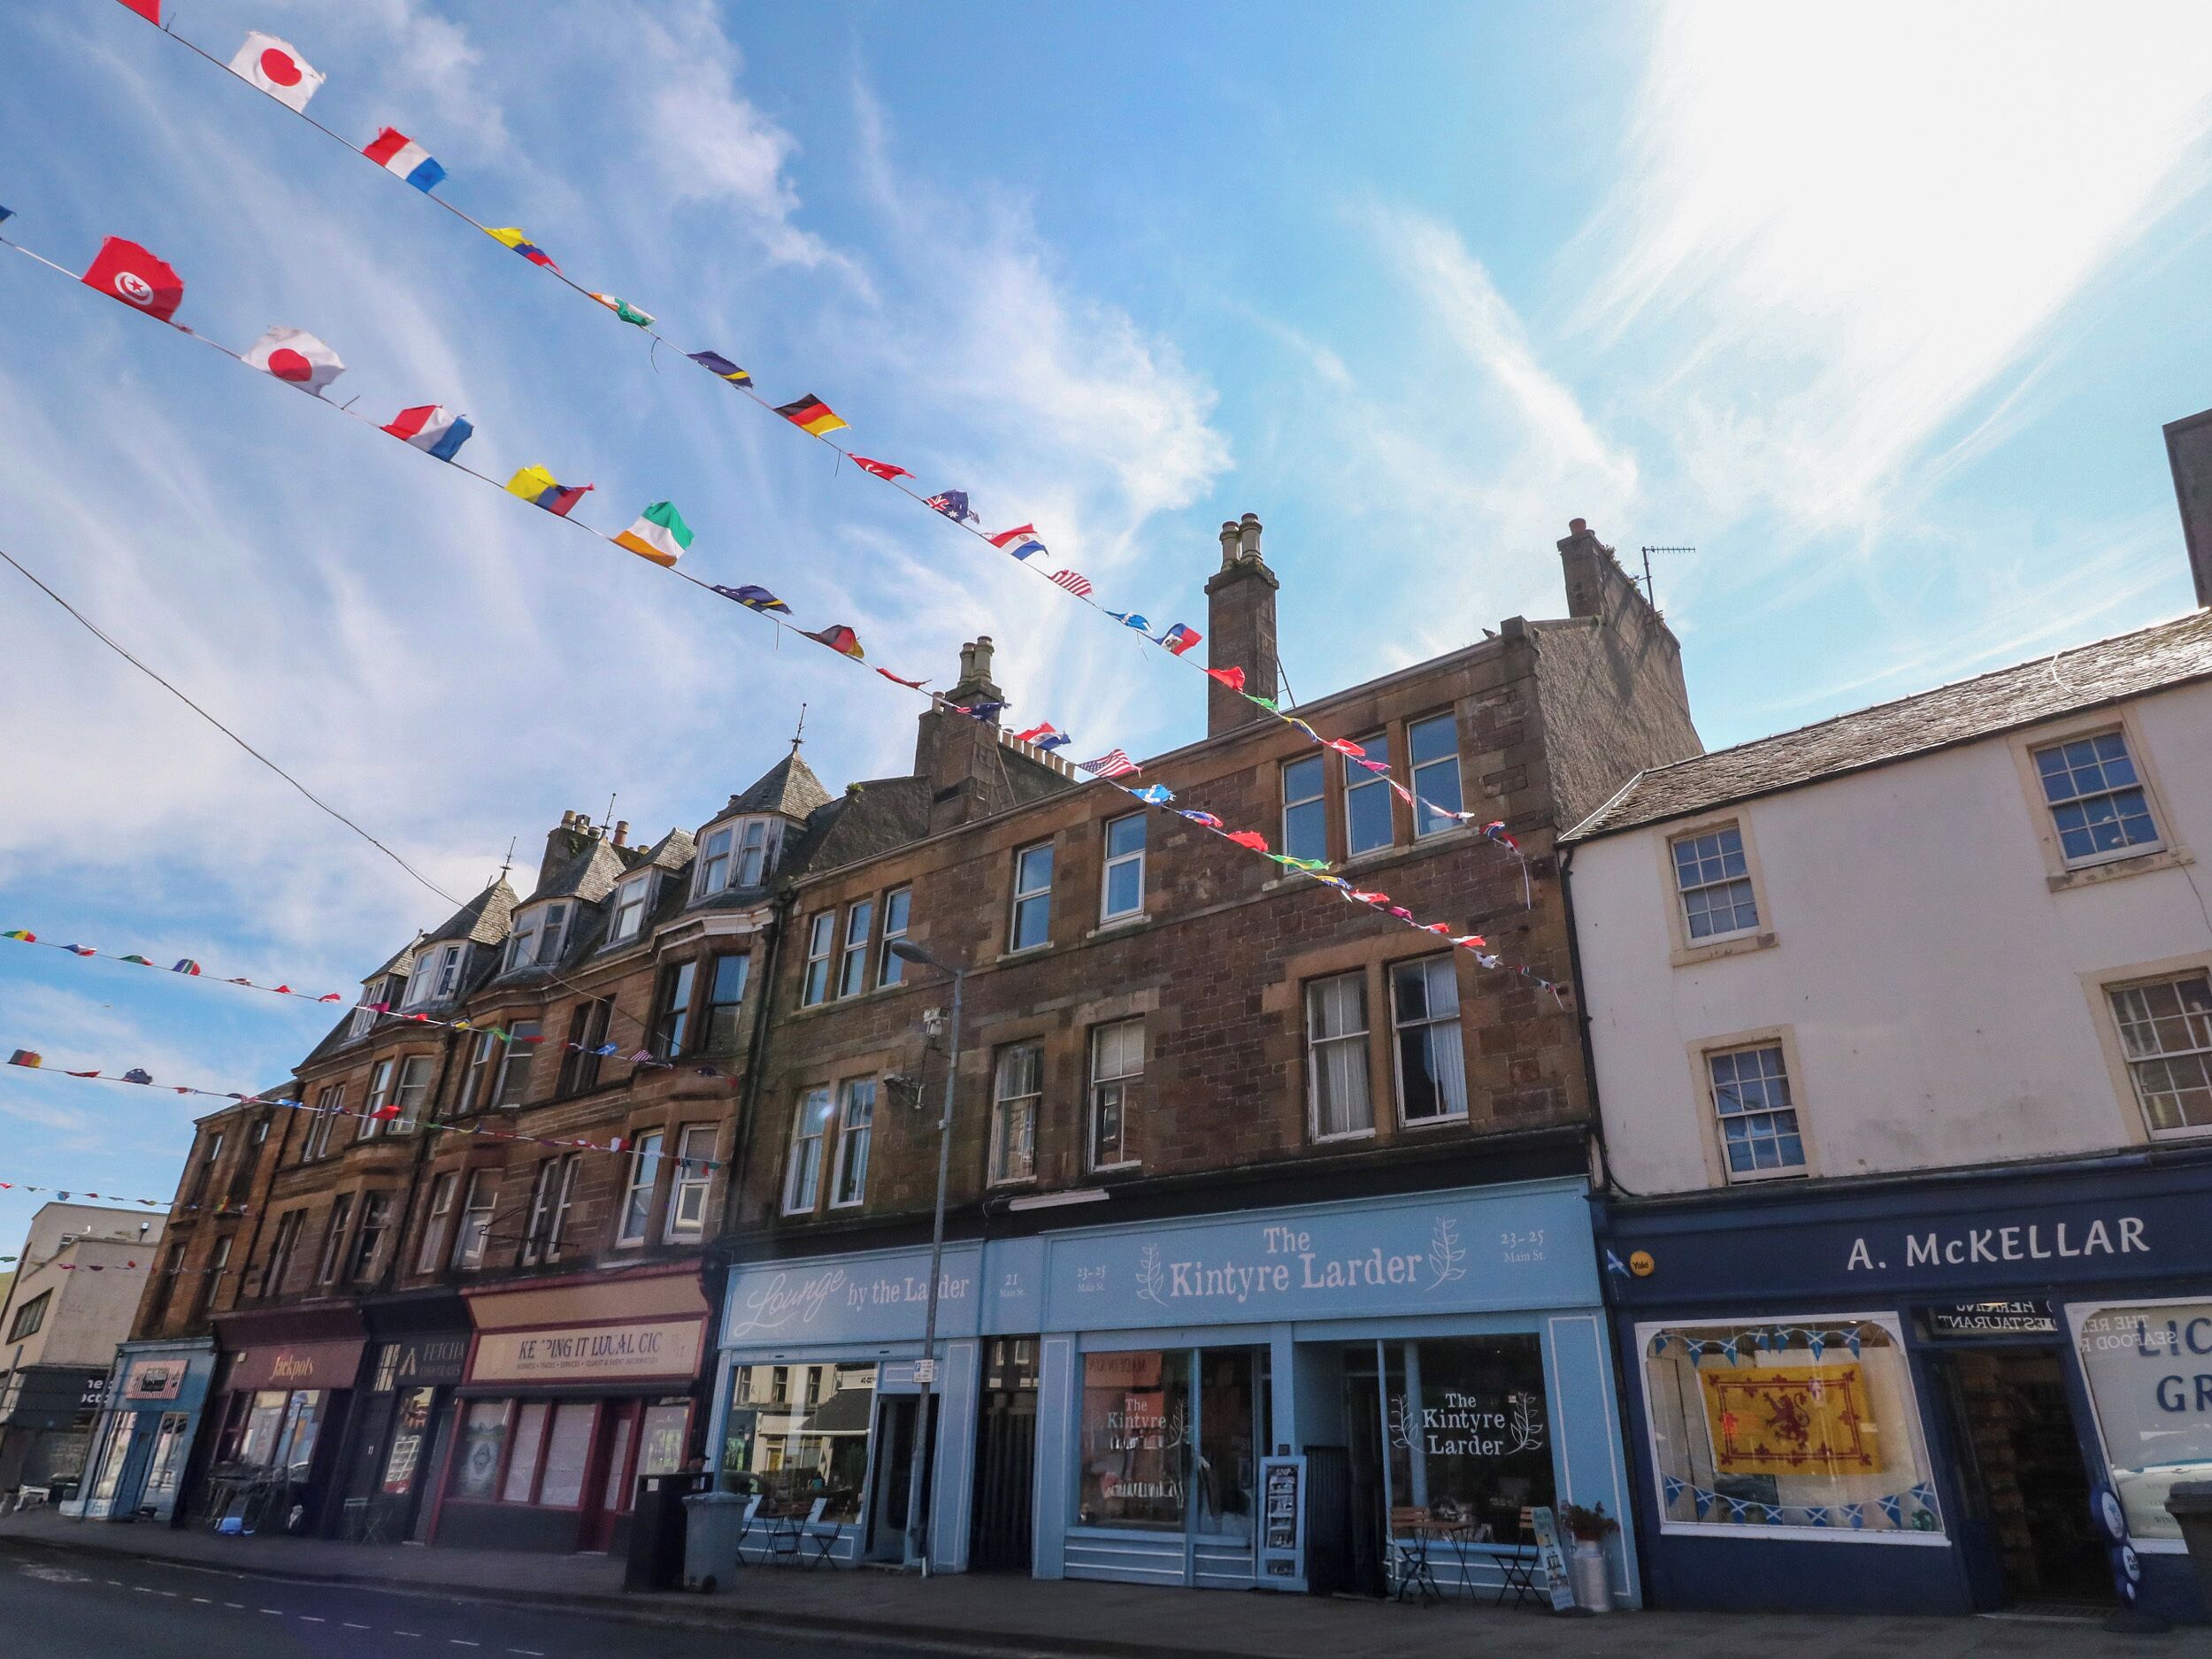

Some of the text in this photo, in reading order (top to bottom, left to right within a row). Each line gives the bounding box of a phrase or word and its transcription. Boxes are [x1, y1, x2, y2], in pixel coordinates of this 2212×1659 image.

[1263, 1226, 1310, 1254] The
[1847, 1217, 2151, 1271] A. McKELLAR
[1503, 1251, 1531, 1263] Main
[1632, 1260, 1649, 1270] Yale
[1004, 1273, 1018, 1286] 21
[1170, 1248, 1423, 1303] Kintyre Larder
[999, 1287, 1015, 1298] Main
[733, 1269, 970, 1338] Lounge by the Lader
[574, 1337, 589, 1356] IT
[638, 1332, 663, 1354] CIC
[268, 1356, 314, 1380] Jackpots
[1125, 1398, 1148, 1412] The
[1445, 1393, 1477, 1408] The
[1107, 1412, 1167, 1430] Kintyre
[1422, 1409, 1506, 1433] Kintyre
[1426, 1435, 1503, 1455] Larder
